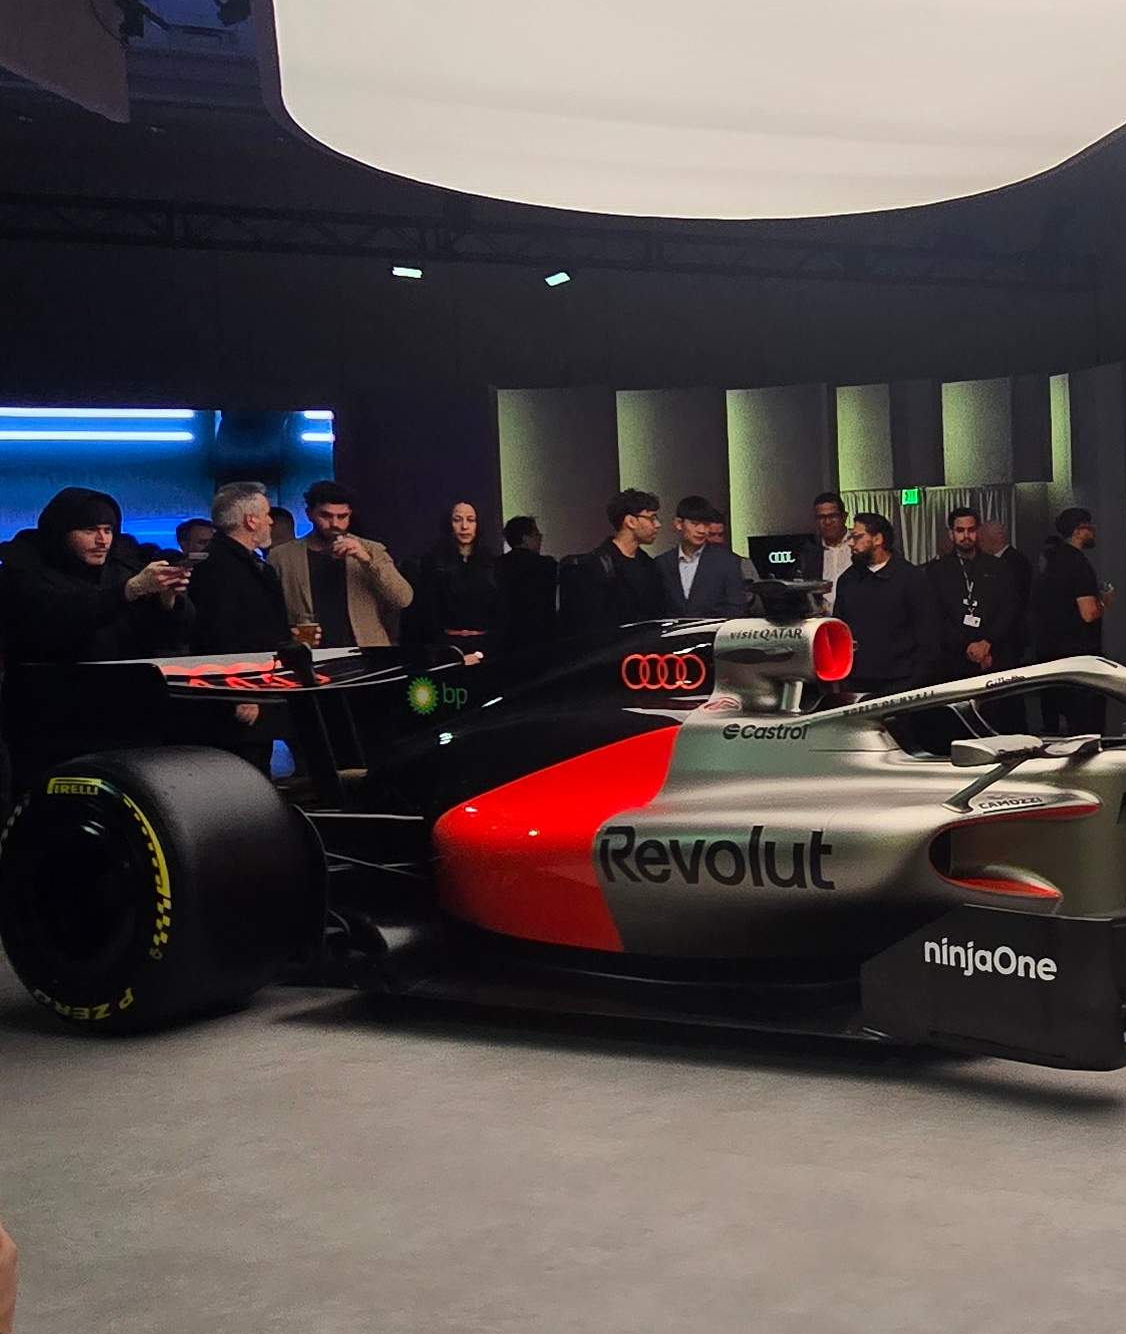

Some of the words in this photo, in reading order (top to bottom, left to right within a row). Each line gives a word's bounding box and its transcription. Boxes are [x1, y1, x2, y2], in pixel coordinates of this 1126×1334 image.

[442, 682, 468, 709] bp
[741, 724, 809, 740] Castrol
[47, 777, 103, 795] PIRELLI
[600, 825, 836, 890] Revolut
[924, 937, 1058, 981] ninjaOne
[119, 987, 134, 1009] P
